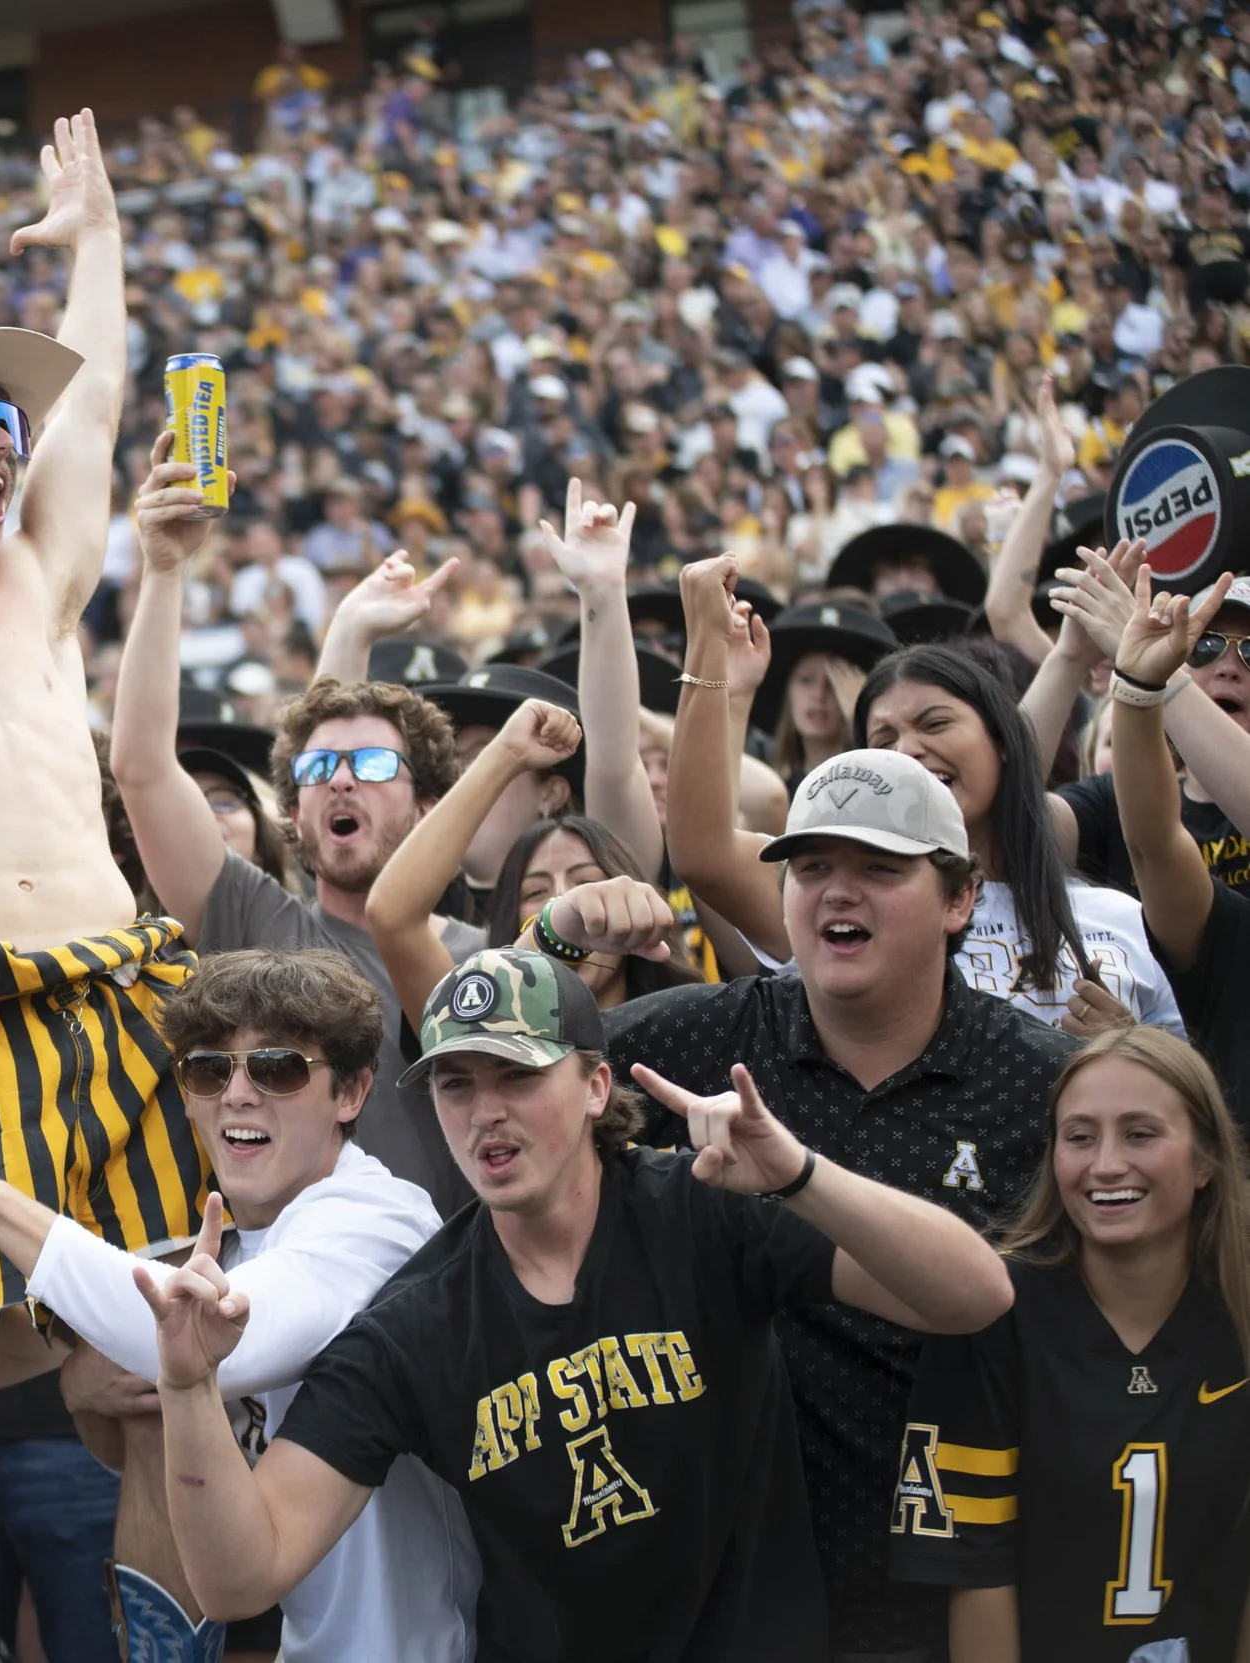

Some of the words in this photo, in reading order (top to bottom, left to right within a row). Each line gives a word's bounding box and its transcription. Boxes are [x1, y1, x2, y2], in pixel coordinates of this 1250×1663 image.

[193, 380, 215, 411] TEA
[191, 413, 218, 488] TWISTED
[1124, 475, 1214, 541] PEPSI
[806, 763, 894, 800] Callaway
[461, 982, 483, 1007] A
[942, 1140, 985, 1191] A
[468, 1372, 542, 1482] APP
[547, 1331, 704, 1433] STATE
[1127, 1366, 1158, 1394] A
[561, 1424, 655, 1548] A
[890, 1422, 954, 1538] A
[1103, 1442, 1173, 1626] 1
